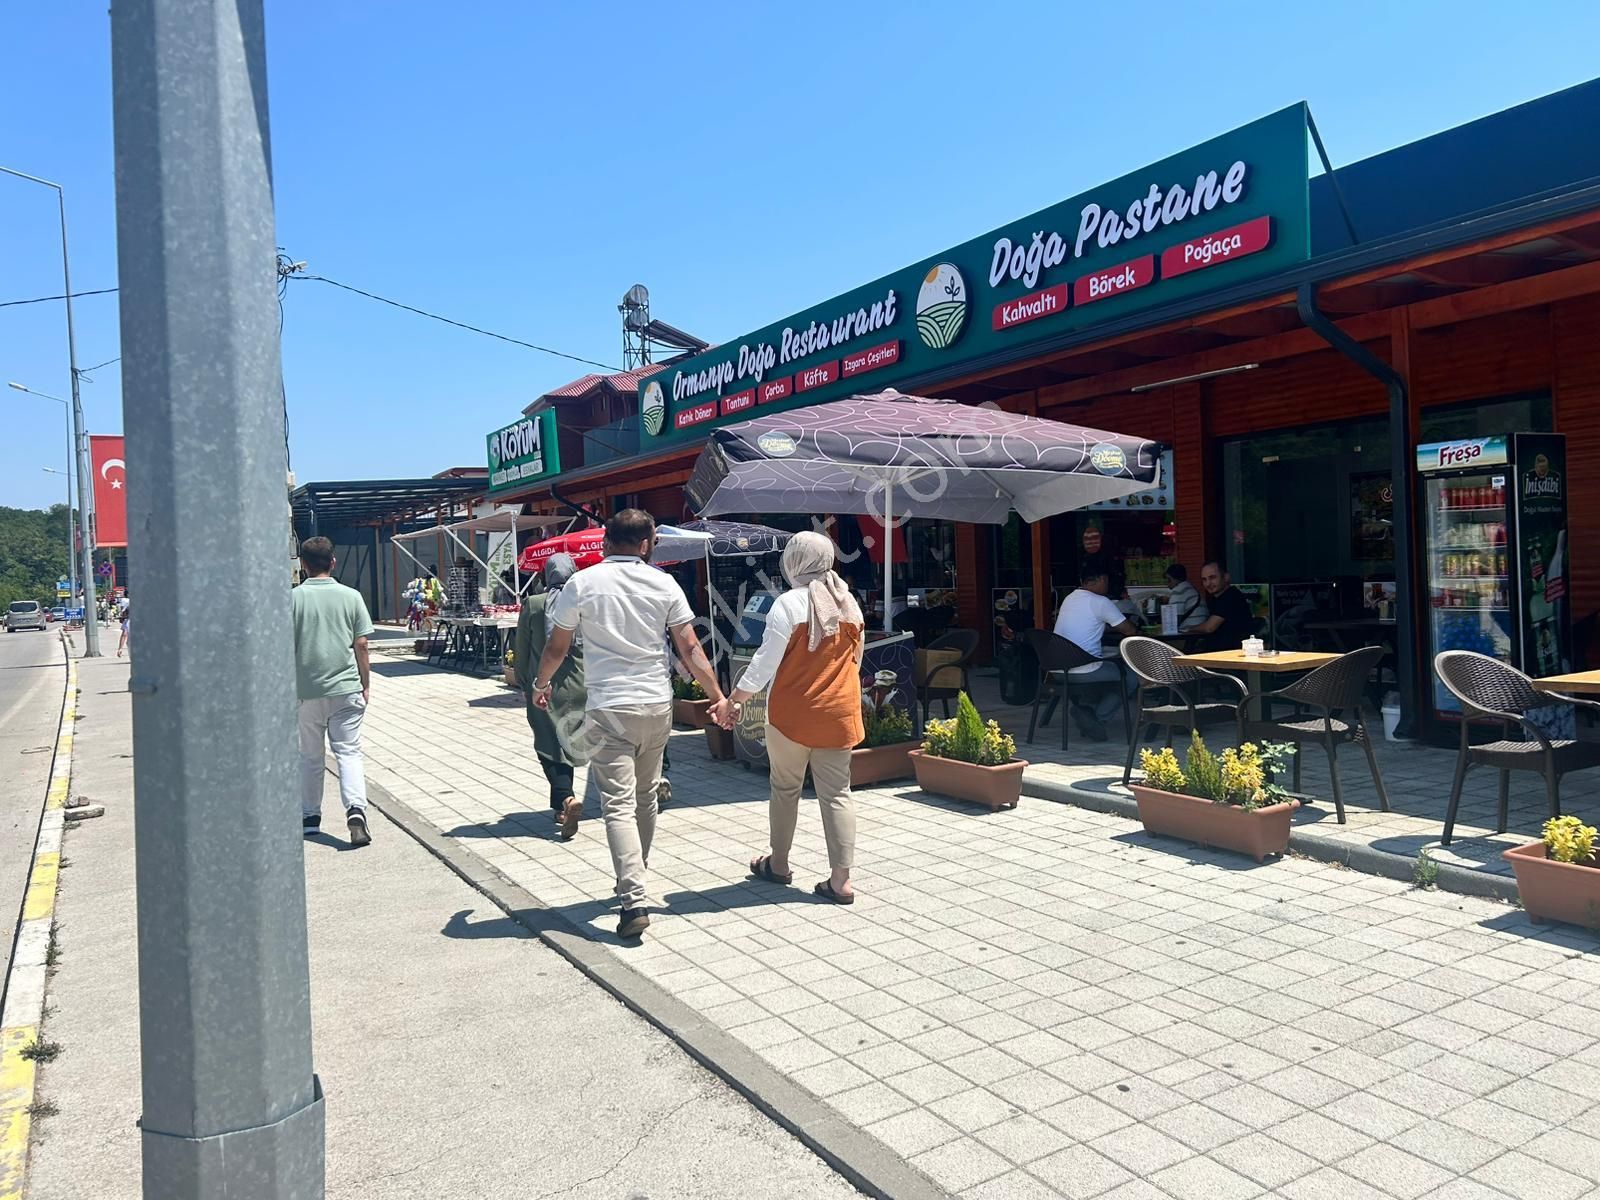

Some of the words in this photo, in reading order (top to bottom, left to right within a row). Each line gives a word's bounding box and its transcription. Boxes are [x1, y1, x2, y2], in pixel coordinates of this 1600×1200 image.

[988, 231, 1067, 289] Doğa
[1074, 160, 1247, 258] Pastane
[1184, 231, 1242, 264] Poğaça
[1088, 266, 1136, 298] Börek
[1001, 294, 1056, 326] Kahvaltı
[672, 359, 735, 402] Ormanya
[737, 342, 776, 383] Doğa
[780, 289, 897, 365] Restaurant
[867, 345, 897, 366] Çeşitleri
[765, 383, 785, 401] Çorba
[803, 368, 829, 388] Köfte
[725, 392, 750, 411] Tantuni
[500, 416, 541, 462] KÖYÜM
[1440, 445, 1480, 466] Freşa
